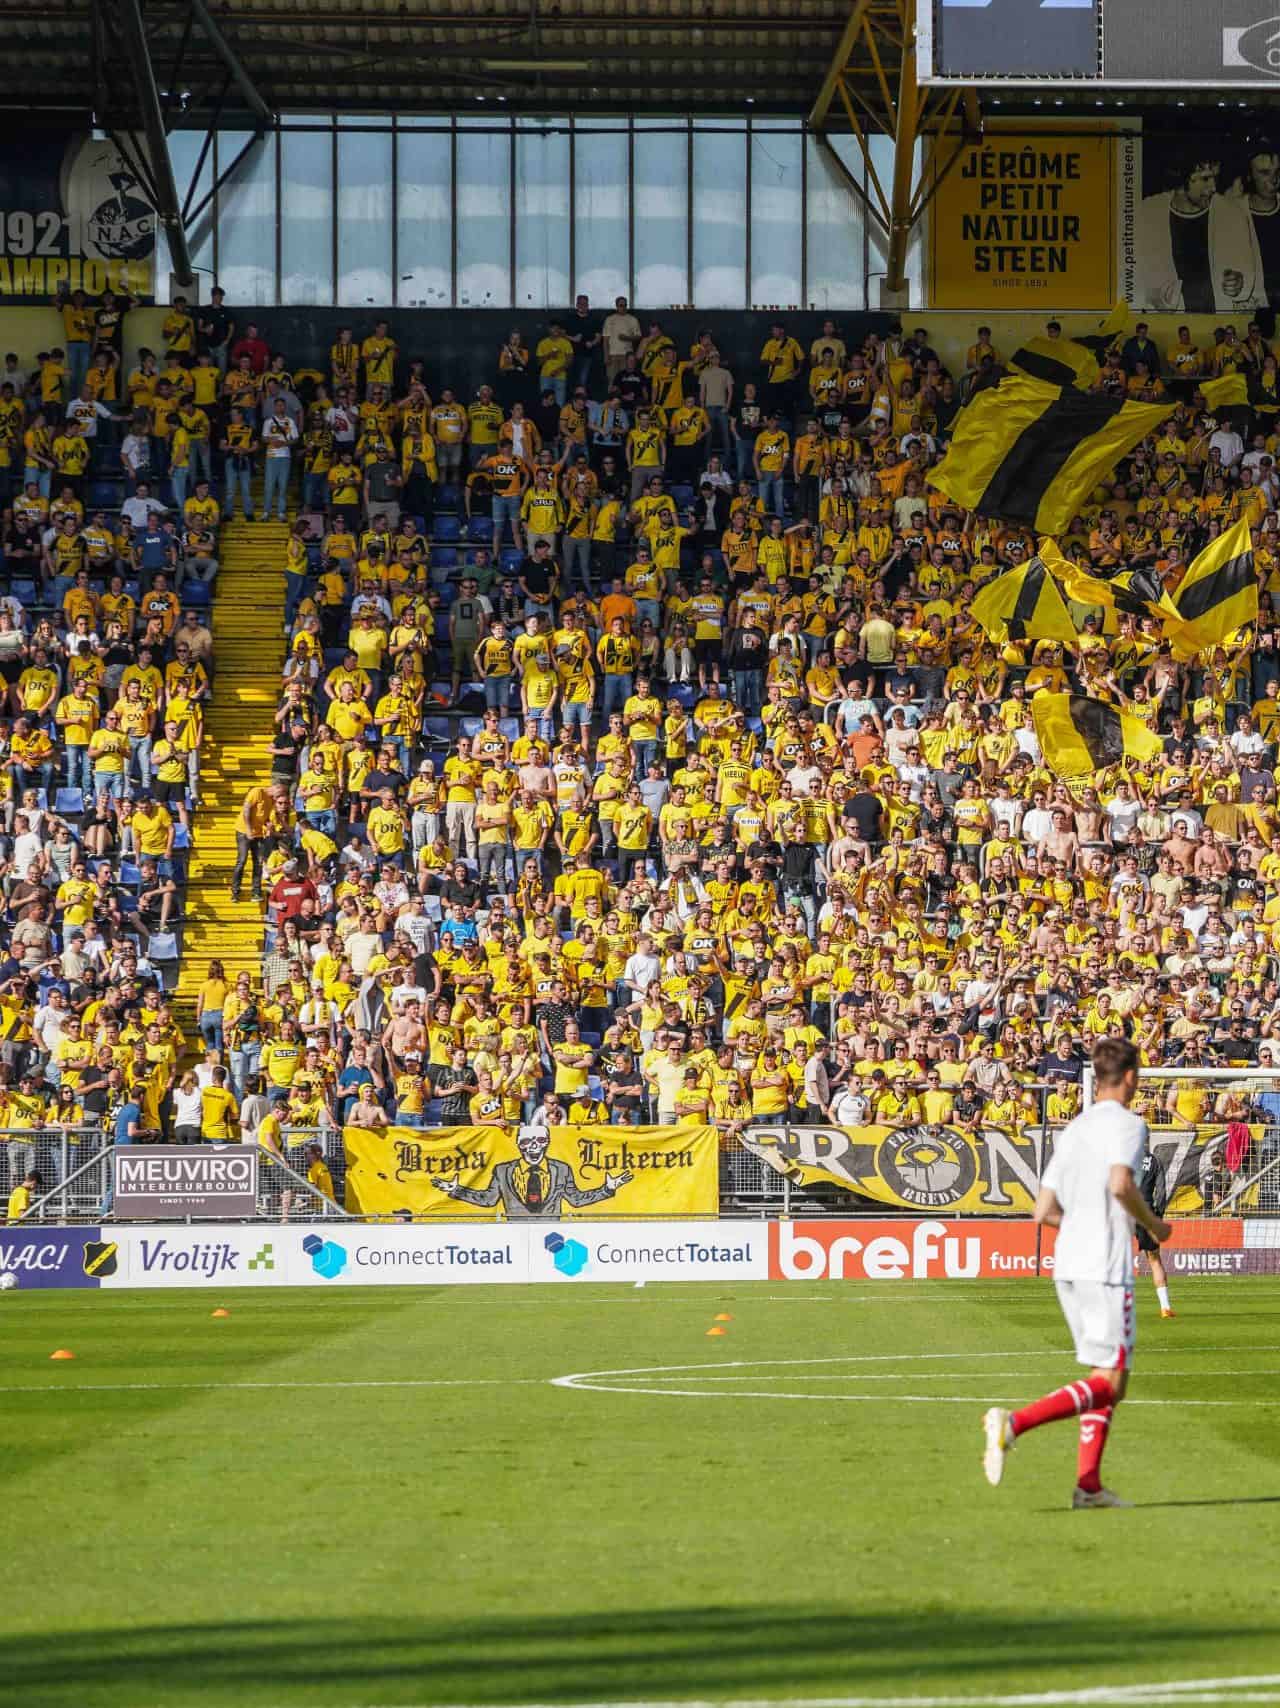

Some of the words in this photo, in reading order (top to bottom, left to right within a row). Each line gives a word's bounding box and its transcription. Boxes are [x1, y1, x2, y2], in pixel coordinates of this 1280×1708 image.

[962, 145, 1080, 179] JÉRÔME
[980, 183, 1063, 210] PETIT
[1121, 128, 1137, 304] www.petitnatuursteen.l
[962, 214, 1080, 242] NATUUR
[0, 210, 82, 256] 921
[974, 246, 1067, 273] STEEN
[100, 312, 119, 324] OK
[820, 379, 837, 388] OK
[849, 378, 865, 388] OK
[74, 408, 92, 416] OK
[408, 416, 422, 424] OK
[637, 440, 655, 448] OK
[762, 446, 779, 454] OK
[497, 465, 516, 474] OK
[656, 538, 674, 546] OK
[905, 537, 924, 545] OK
[942, 541, 960, 549] OK
[1007, 542, 1024, 550] OK
[150, 602, 169, 610] OK
[956, 680, 971, 689] OK
[484, 743, 503, 752] OK
[811, 740, 824, 750] OK
[559, 773, 578, 781] OK
[381, 824, 398, 833] OK
[626, 820, 642, 828] OK
[1238, 879, 1254, 888] OK
[1122, 885, 1140, 894] OK
[693, 939, 714, 949] OK
[771, 986, 788, 994] OK
[481, 1099, 500, 1113] OK
[16, 1110, 33, 1118] OK
[295, 1117, 312, 1126] OK
[393, 1140, 487, 1183] Breda
[577, 1138, 693, 1180] Lokeren
[121, 1159, 249, 1182] MEUVIRO
[121, 1181, 249, 1192] INTERIEURBOUW
[902, 1187, 963, 1206] BREDA
[597, 1243, 752, 1264] ConnectTotaal
[779, 1221, 980, 1279] brefu
[140, 1239, 241, 1278] Vrolijk
[355, 1245, 512, 1266] ConnectTotaal
[1174, 1253, 1244, 1269] UNIBET
